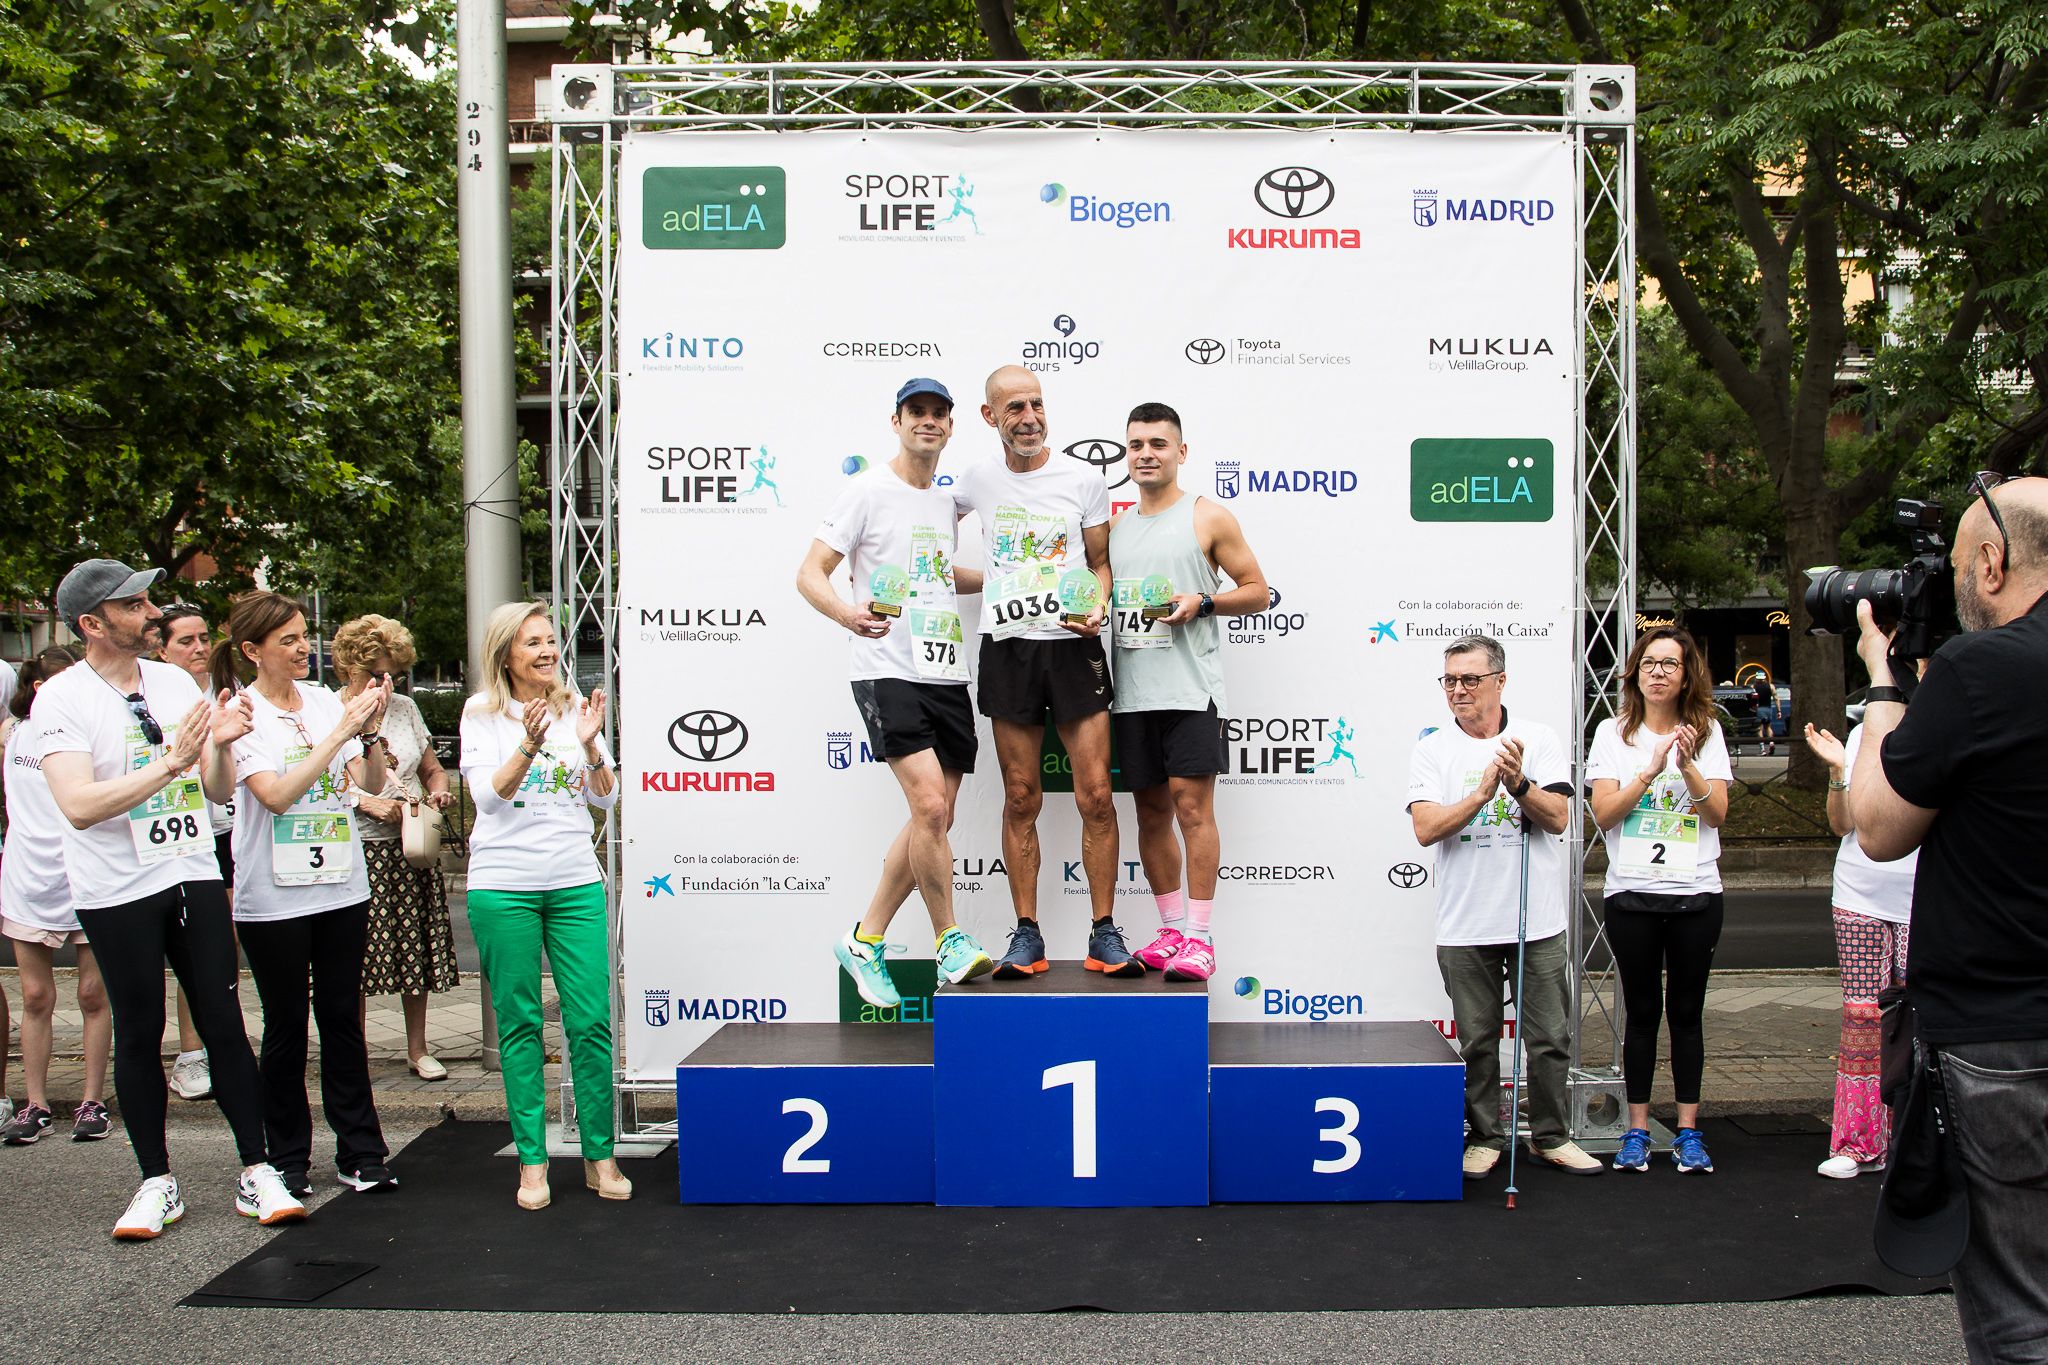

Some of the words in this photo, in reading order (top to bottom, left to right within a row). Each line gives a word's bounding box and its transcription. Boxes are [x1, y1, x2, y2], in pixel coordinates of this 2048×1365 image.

[845, 174, 949, 198] SPORT
[662, 203, 766, 231] adELA
[859, 203, 936, 231] LIFE
[1070, 195, 1170, 228] Biogen
[1446, 199, 1554, 226] MADRID
[1022, 341, 1100, 365] amigo
[1237, 338, 1281, 350] Toyota
[1430, 338, 1554, 356] MUKUA
[642, 363, 672, 373] Flexible
[674, 363, 706, 374] Mobility
[708, 363, 744, 373] Solutions
[1237, 353, 1295, 365] Financial
[1299, 353, 1351, 365] Services
[647, 446, 752, 471] SPORT
[662, 476, 737, 503] LIFE
[1248, 470, 1357, 497] MADRID
[1430, 476, 1534, 503] adELA
[992, 592, 1060, 626] 1036
[1398, 600, 1416, 610] Con
[1420, 600, 1432, 610] la
[1435, 600, 1500, 610] colaboración
[1502, 600, 1523, 610] de:
[641, 608, 767, 627] MUKUA
[1117, 611, 1155, 633] 749
[1228, 613, 1305, 637] amigo
[641, 630, 656, 643] by
[1229, 633, 1266, 644] tours
[1406, 623, 1483, 638] Fundación
[923, 640, 956, 666] 378
[1227, 717, 1329, 742] SPORT
[1240, 747, 1315, 774] LIFE
[150, 814, 199, 844] 698
[291, 820, 338, 840] ELA
[309, 846, 324, 868] 3
[673, 854, 695, 864] Con
[698, 854, 707, 864] la
[711, 854, 780, 864] colaboración
[782, 854, 799, 864] de:
[1650, 842, 1666, 864] 2
[681, 876, 759, 891] Fundación
[678, 998, 788, 1023] MADRID
[1264, 989, 1363, 1021] Biogen
[1042, 1060, 1097, 1179] 1
[781, 1097, 831, 1174] 2
[1312, 1097, 1362, 1174] 3
